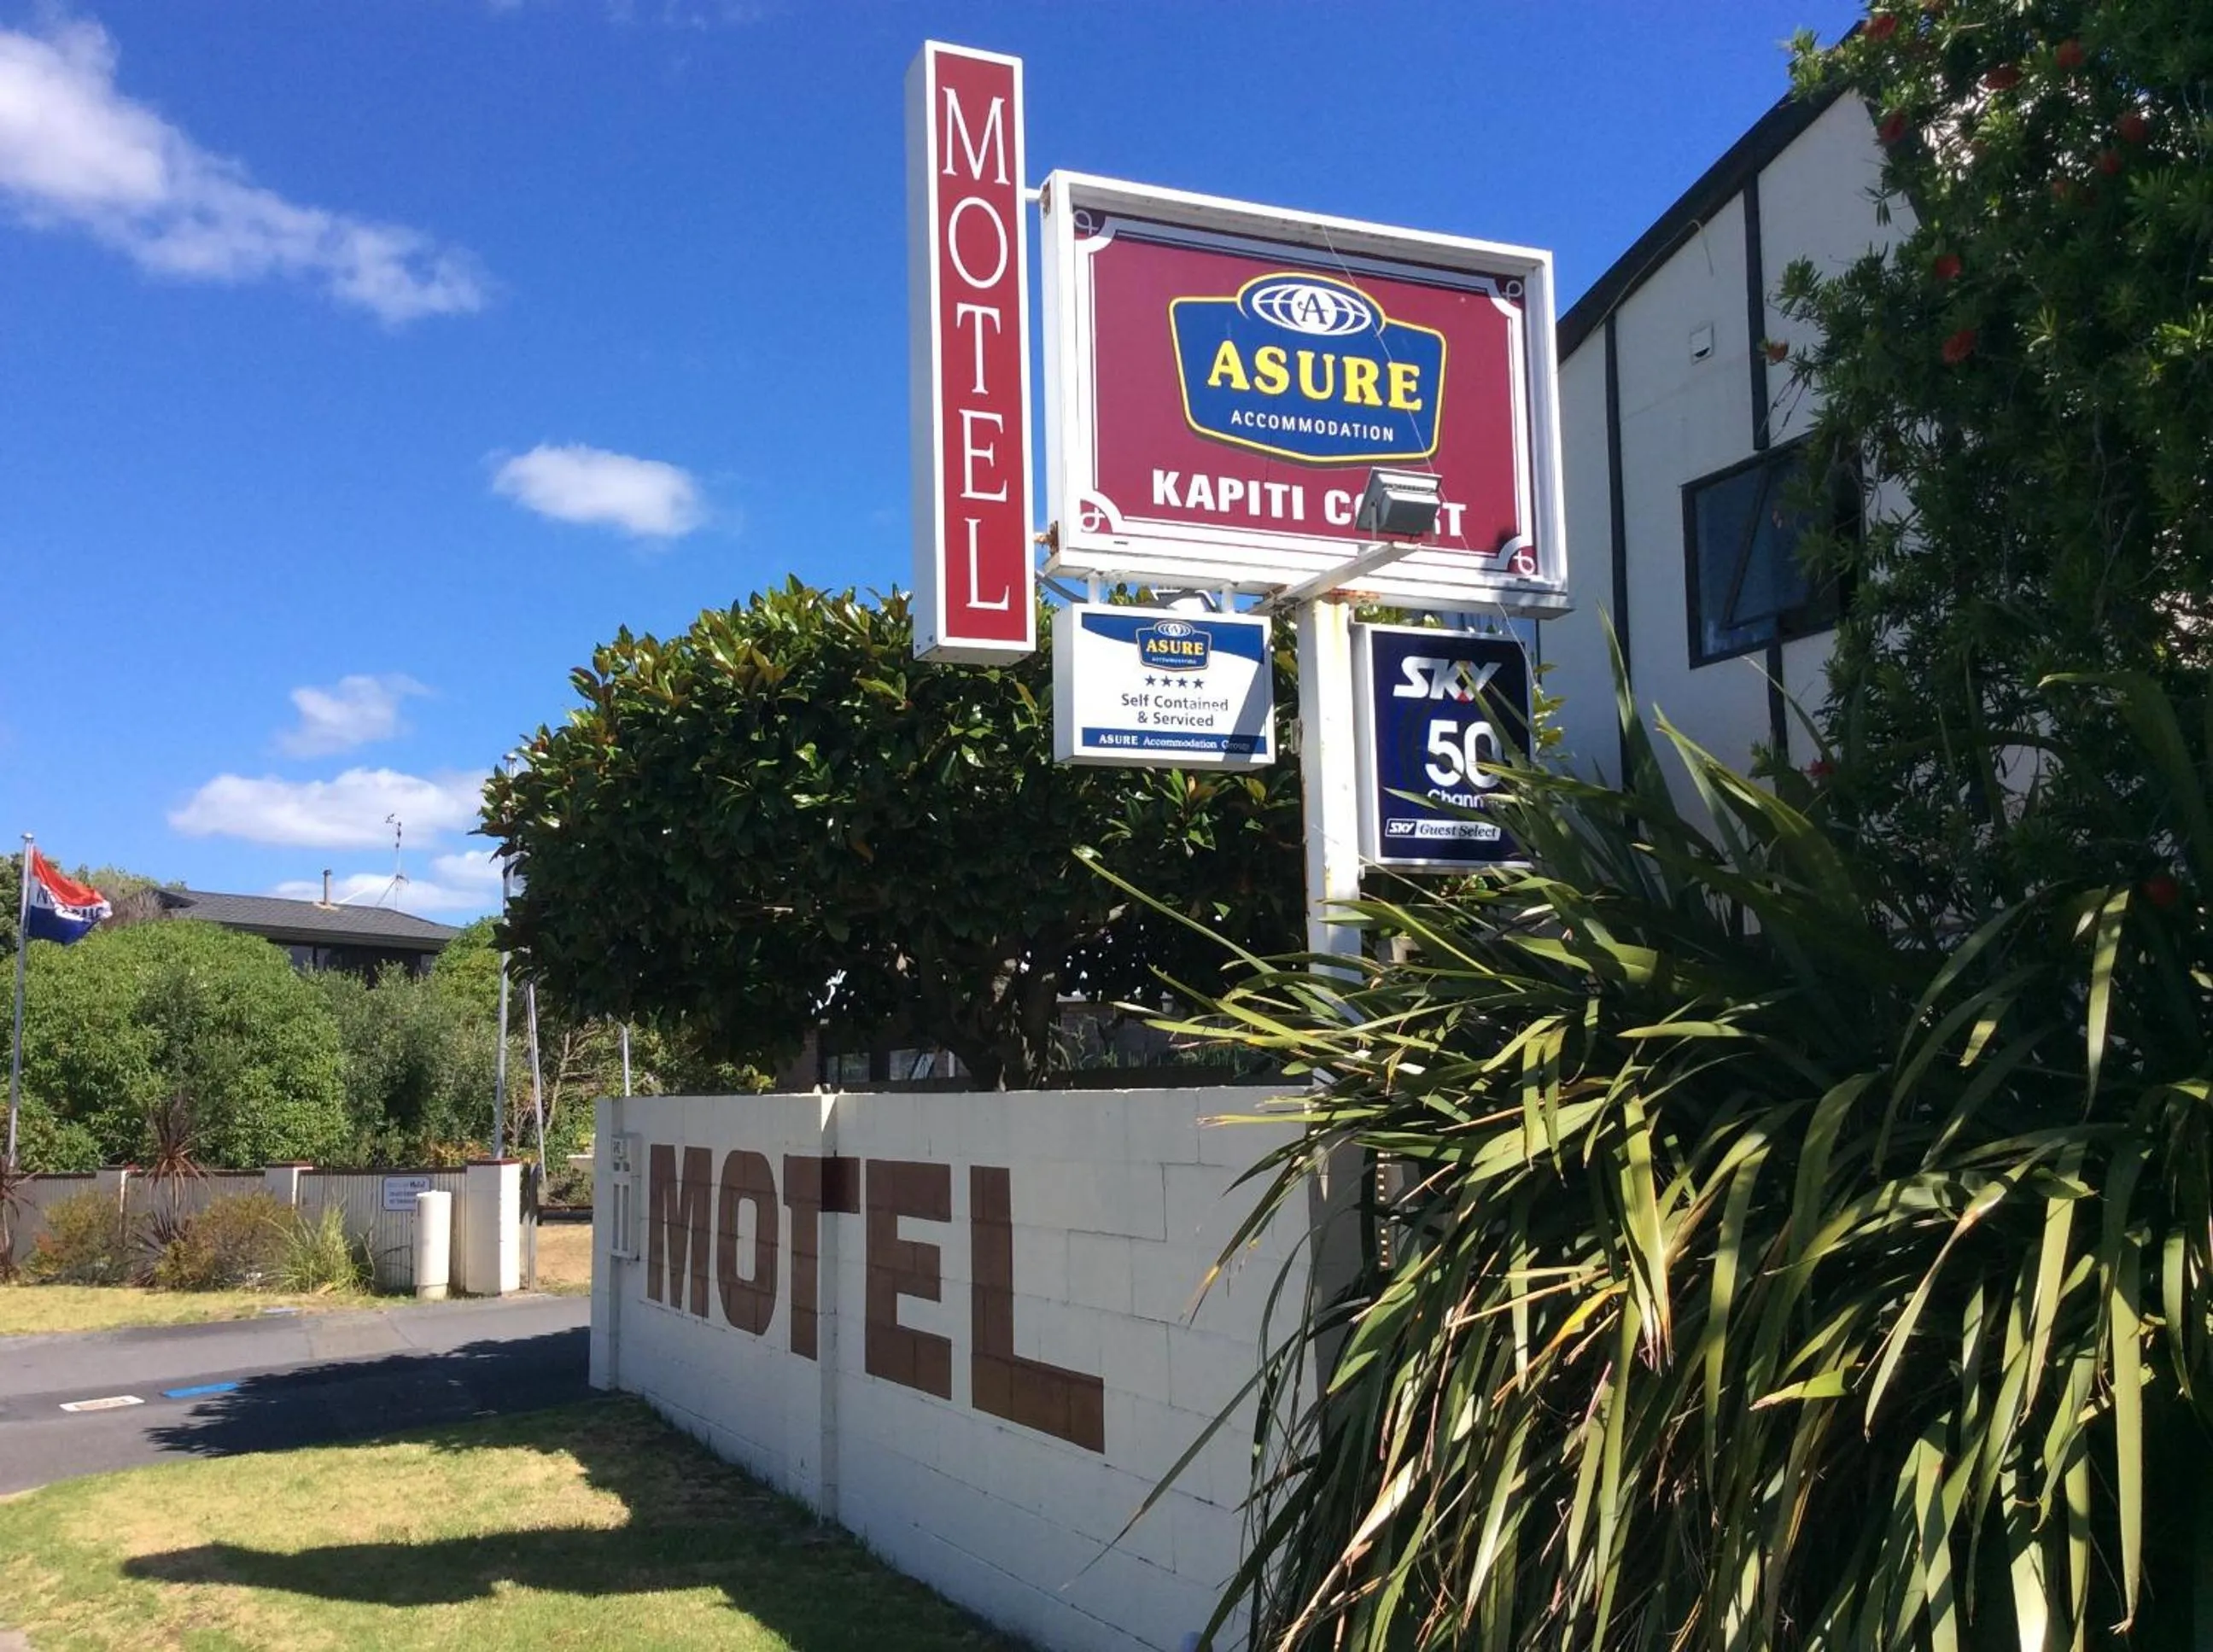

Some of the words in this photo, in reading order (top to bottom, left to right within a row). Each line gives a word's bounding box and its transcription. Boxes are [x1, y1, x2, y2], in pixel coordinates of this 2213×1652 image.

[942, 86, 1010, 611] MOTEL
[1207, 340, 1423, 412] ASURE
[1230, 410, 1394, 442] ACCOMMODATION
[1153, 468, 1305, 522] KAPITI
[1146, 638, 1205, 656] ASURE
[1393, 655, 1503, 703] SKY
[1121, 692, 1149, 707] Self
[1154, 695, 1229, 711] Contained
[1137, 710, 1148, 724] &
[1153, 712, 1214, 727] Serviced
[1099, 733, 1138, 745] ASURE
[1143, 736, 1217, 749] Accommodation
[1424, 719, 1504, 788] 50
[1390, 822, 1415, 834] SKY
[1420, 823, 1457, 836] Guest
[1458, 824, 1497, 838] Select
[647, 1144, 1105, 1456] MOTEL
